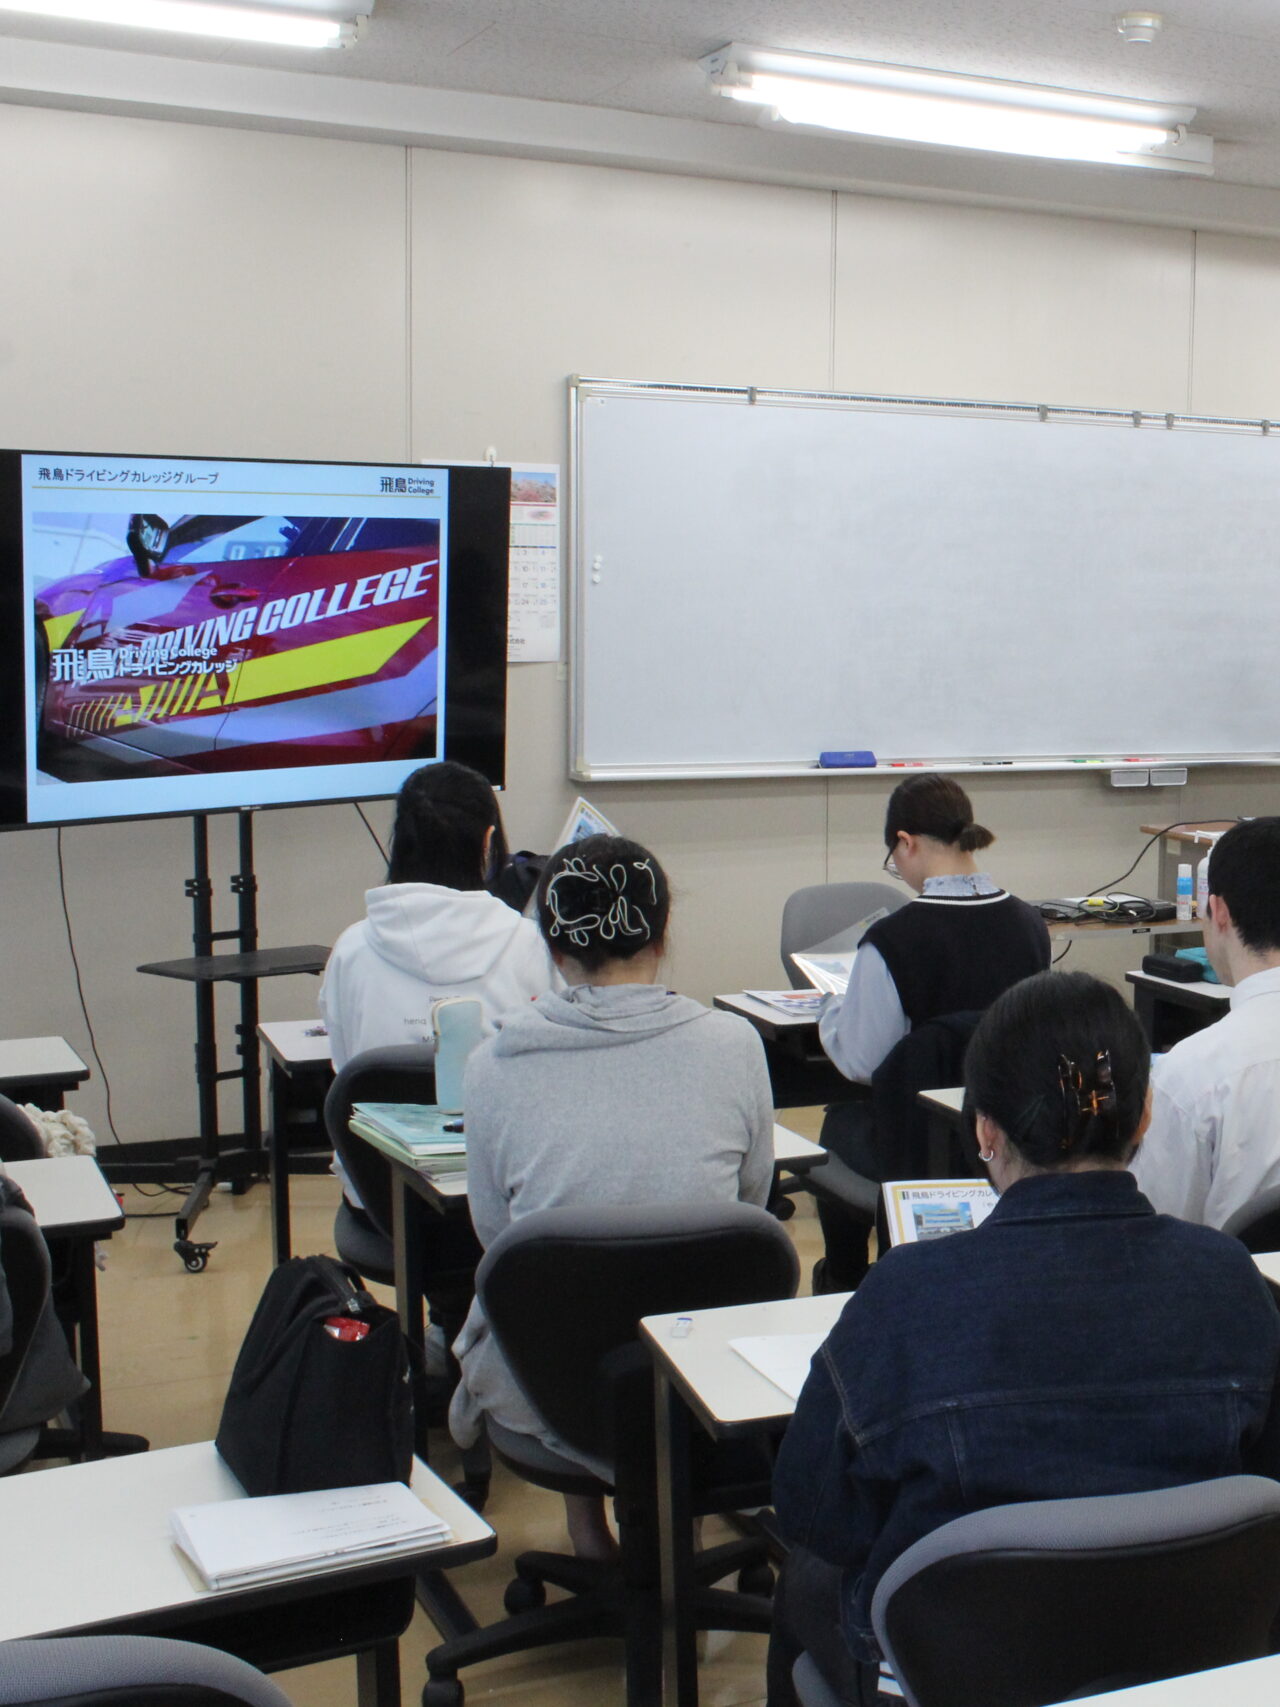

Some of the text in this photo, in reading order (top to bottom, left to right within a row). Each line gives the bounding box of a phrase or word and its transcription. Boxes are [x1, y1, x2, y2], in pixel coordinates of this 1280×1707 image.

[38, 467, 219, 485] 飛鳥ドライビングカレッジグループ
[380, 476, 407, 493] 飛鳥
[408, 478, 434, 487] Driving
[408, 486, 434, 495] College
[256, 559, 439, 637] COLLEGE
[119, 647, 218, 661] Driving College
[53, 649, 115, 682] 飛鳥
[118, 659, 238, 677] ドライビングカレッジ
